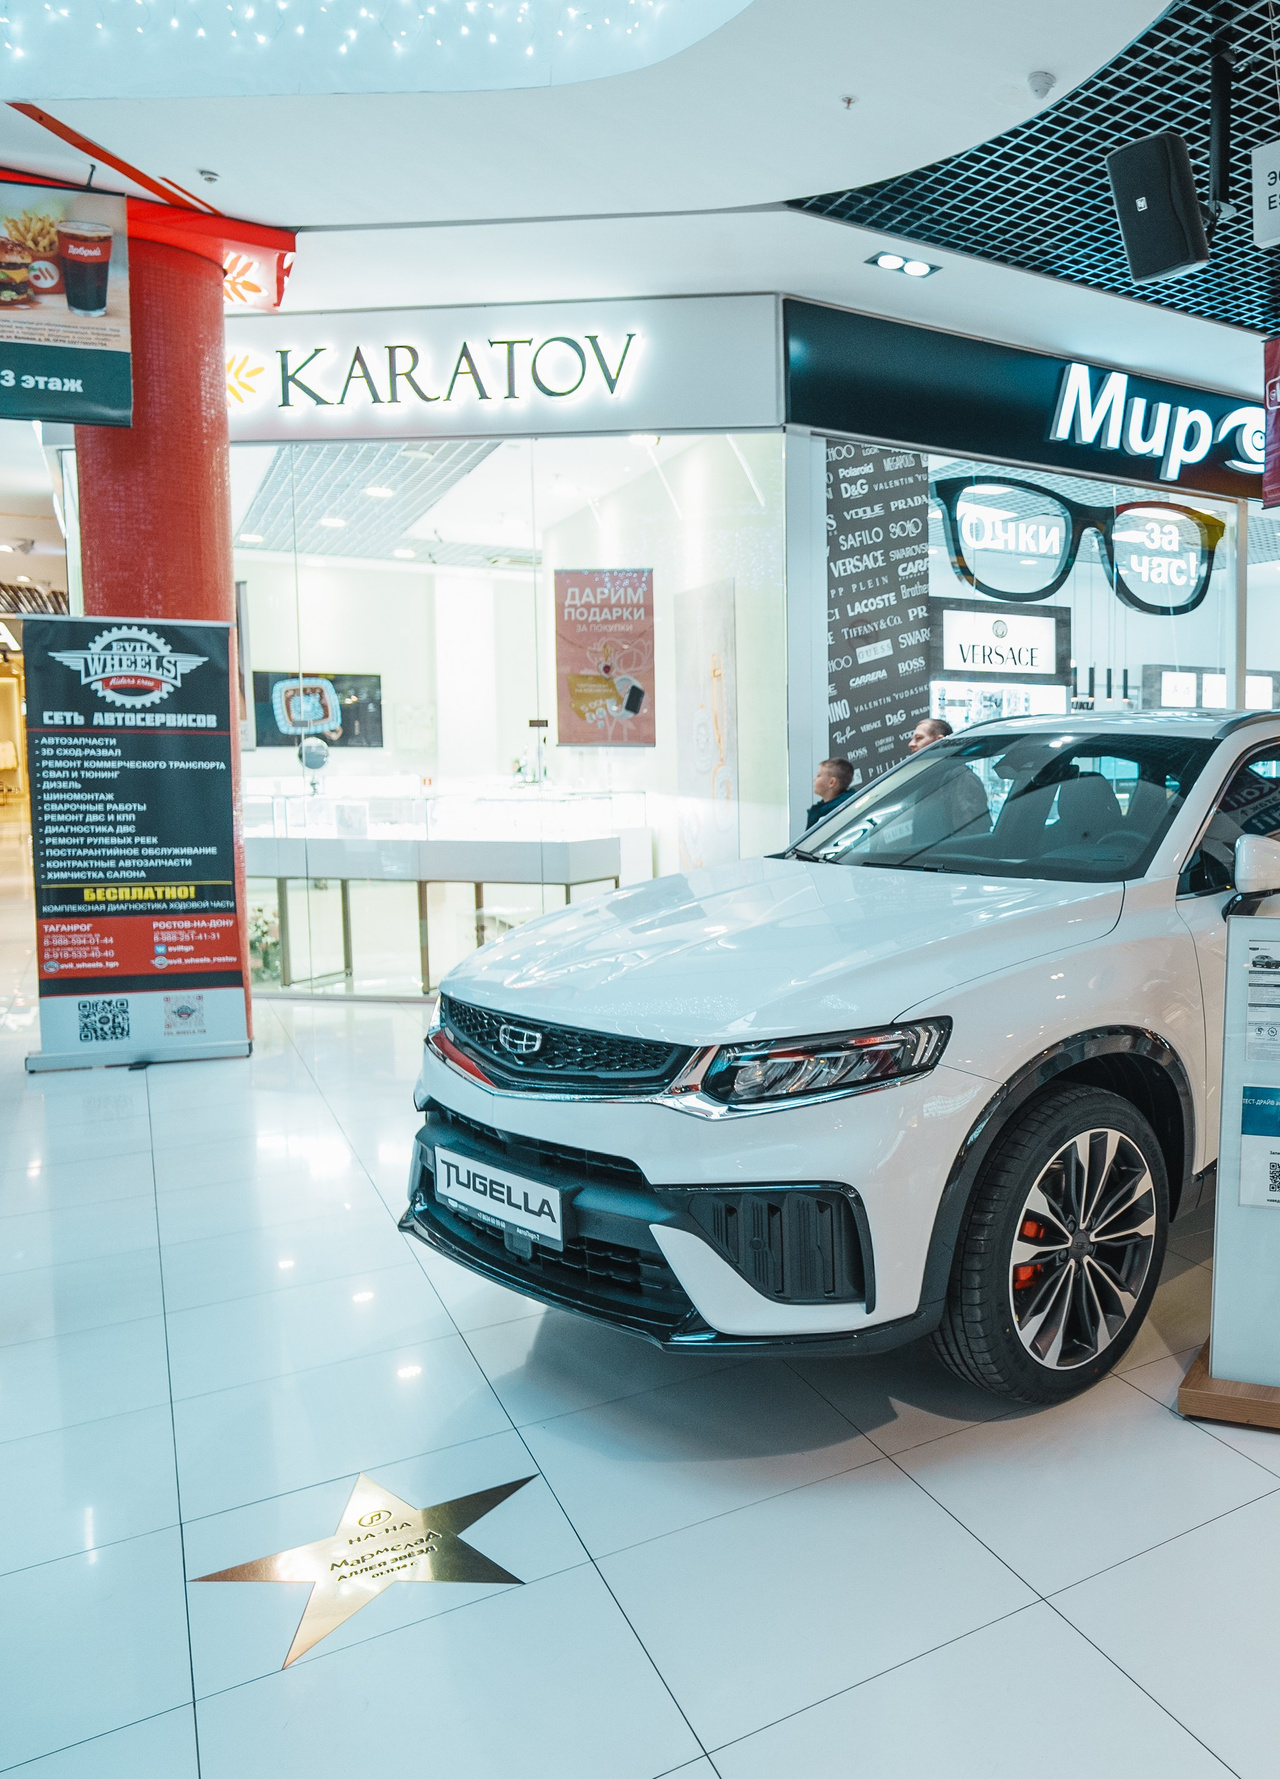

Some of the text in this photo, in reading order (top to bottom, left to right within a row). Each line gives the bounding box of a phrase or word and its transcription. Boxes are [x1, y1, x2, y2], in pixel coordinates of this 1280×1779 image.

[277, 333, 637, 408] KARATOV
[0, 369, 84, 393] 3 этаж
[1050, 362, 1213, 482] Мир
[838, 462, 874, 479] Polaroid
[840, 476, 914, 499] D&G VALENTIN
[843, 494, 928, 520] VOGUE PRADA
[839, 518, 922, 551] SAFILO SOLO
[961, 510, 1060, 555] Очки
[1144, 522, 1179, 551] за
[830, 549, 886, 578] VERSACE
[1131, 552, 1197, 586] час!
[851, 575, 889, 593] PLEIN
[564, 587, 645, 607] ДАРИМ
[846, 592, 897, 617] LACOSTE
[563, 607, 645, 622] ПОДАРКИ
[576, 624, 633, 633] ЗА ПОКУПКИ
[112, 641, 152, 653] EVIL
[858, 643, 893, 660] GUESS
[958, 644, 1039, 667] VERSACE
[86, 654, 177, 679] WHEELS
[898, 656, 926, 674] BOSS
[850, 669, 888, 687] CARRERA
[43, 711, 217, 728] СЕТЬ АВТОСЕРВИСОВ
[41, 737, 117, 746] АВТОЗАПЧАСТИ
[41, 748, 121, 757] 3D СХОД-РАЗВАЛ
[42, 760, 226, 770] РЕМОНТ КОММЕРЧЕСКОГО ТРАНСПОРТА
[42, 770, 120, 779] СВАП И ТЮНИНГ
[42, 781, 82, 790] ДИЗЕЛЬ
[43, 792, 114, 801] ШИНОМОНТАЖ
[44, 803, 146, 812] СВАРОЧНЫЕ РАБОТЫ
[44, 813, 136, 823] РЕМОНТ ДВС И КПП
[44, 825, 136, 834] ДИАГНОСТИКА ДВС
[45, 836, 158, 845] РЕМОНТ РУЛЕВЫХ РЕЕК
[46, 847, 217, 857] ПОСТГАРАНТИЙНОЕ ОБСЛУЖИВАНИЕ
[46, 858, 192, 869] КОНТРАКТНЫЕ АВТОЗАПЧАСТИ
[47, 870, 146, 880] ХИМЧИСТКА САЛОНА
[84, 886, 196, 902] БЕСПЛАТНО!
[42, 901, 234, 914] КОМПЛЕКСНАЯ ДИАГНОСТИКА ХОДОВОЙ ЧАСТИ
[43, 923, 93, 932] ТАГАНРОГ
[152, 919, 234, 930] РОСТОВ-НА-ДОНУ
[440, 1159, 556, 1223] TUGELLA
[337, 1561, 387, 1581] АЛЛЕЯ
